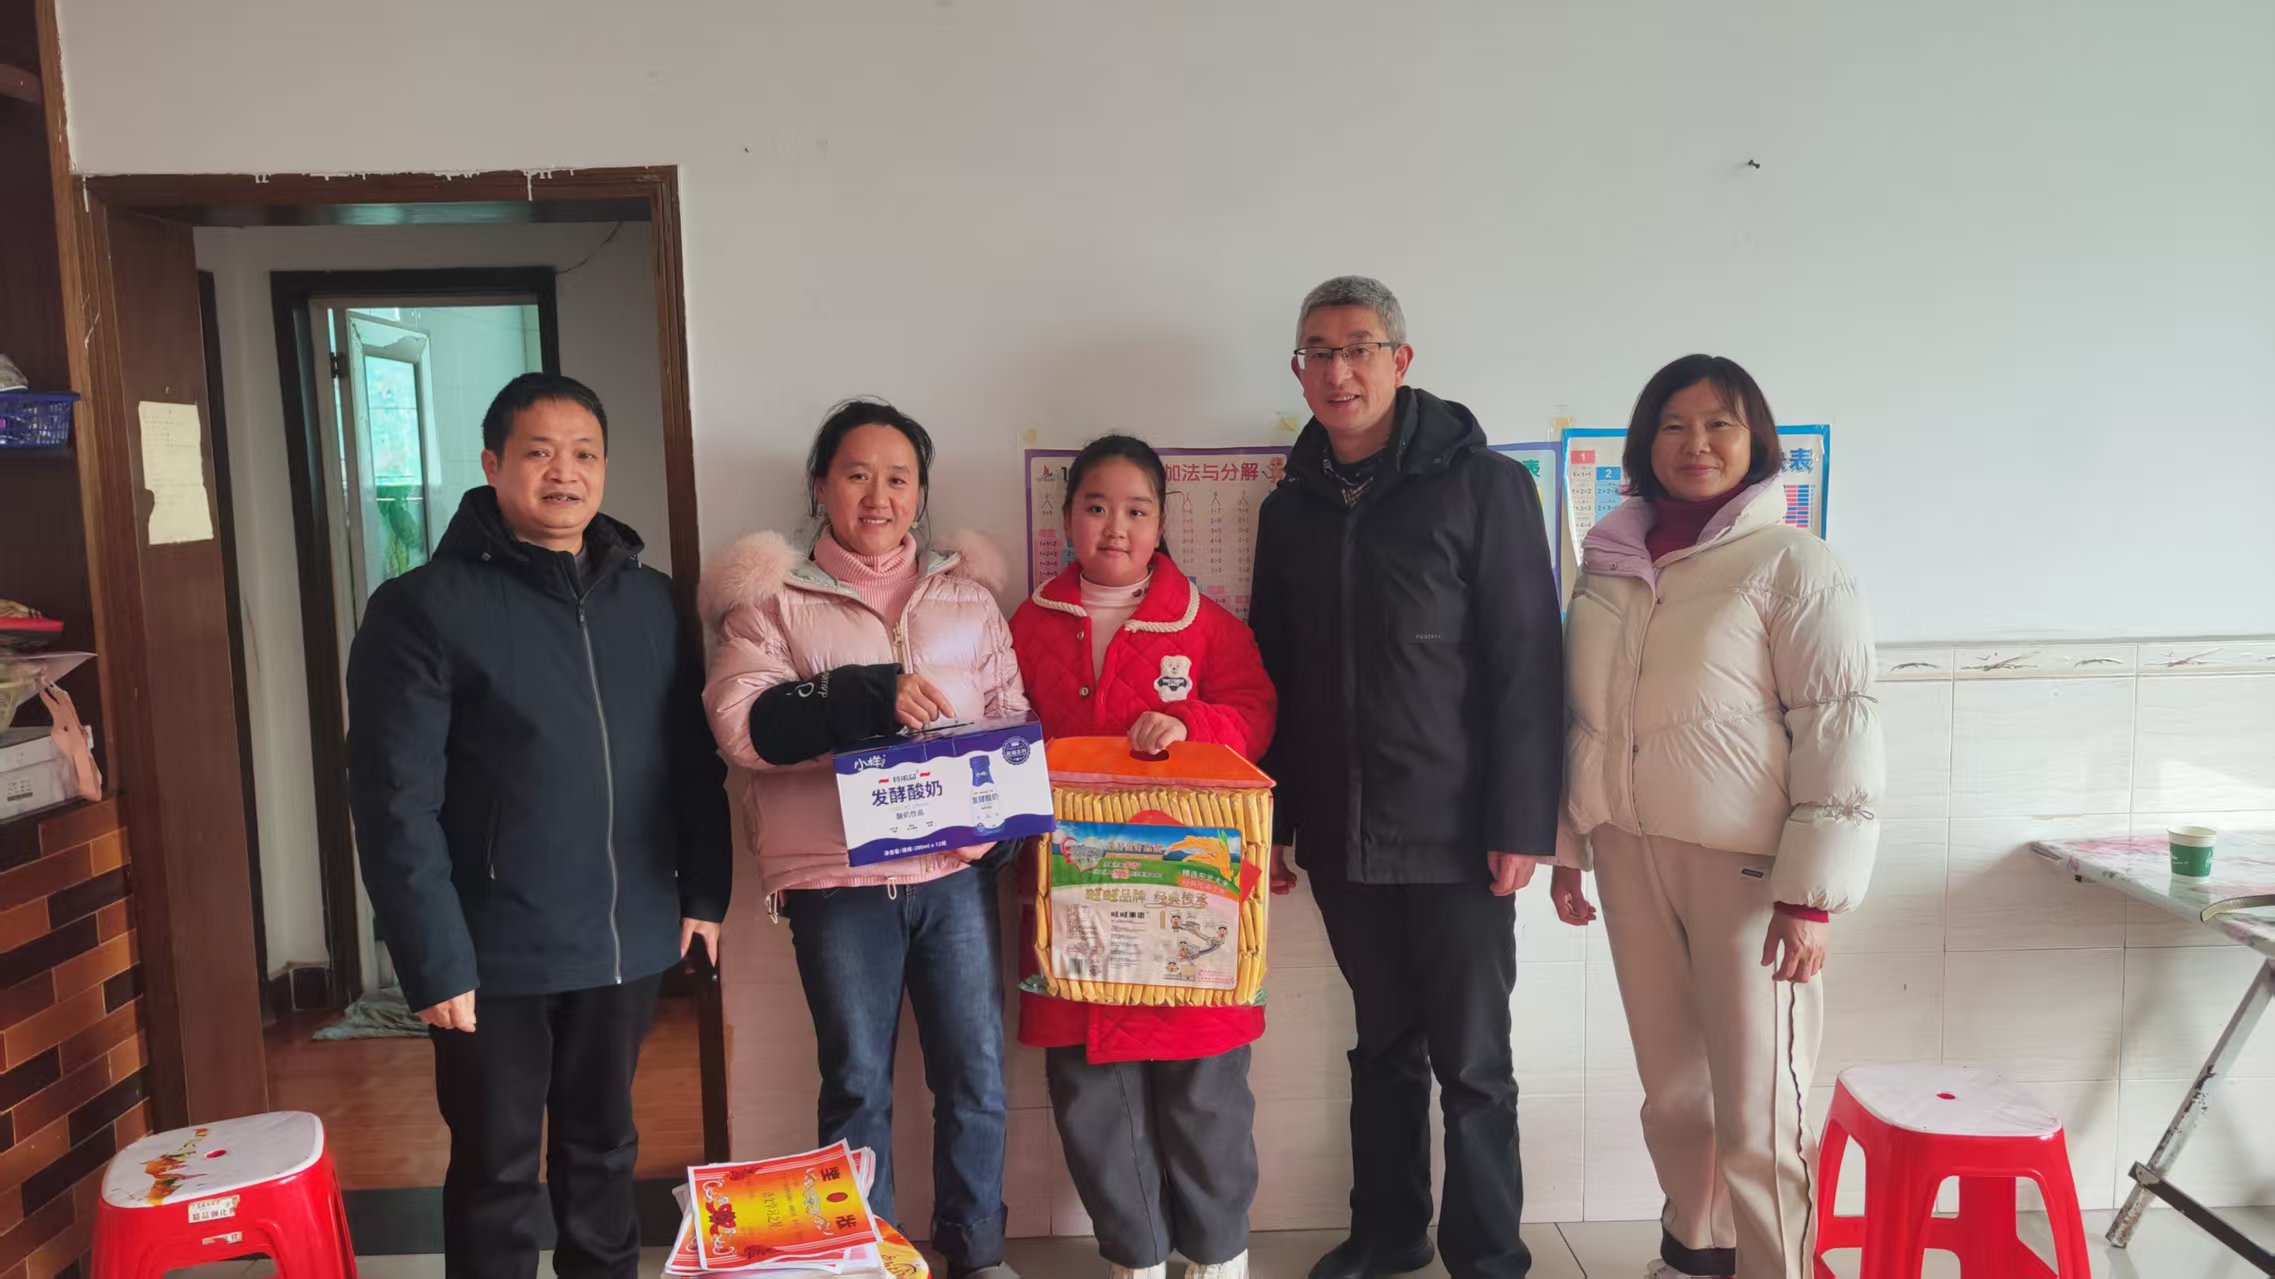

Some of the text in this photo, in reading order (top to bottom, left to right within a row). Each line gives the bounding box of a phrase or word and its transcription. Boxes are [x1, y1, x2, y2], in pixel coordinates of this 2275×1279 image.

[1580, 453, 1586, 462] 1
[1165, 462, 1259, 482] 加法与分解
[1605, 469, 1612, 478] 2
[871, 780, 943, 807] 发酵酸奶
